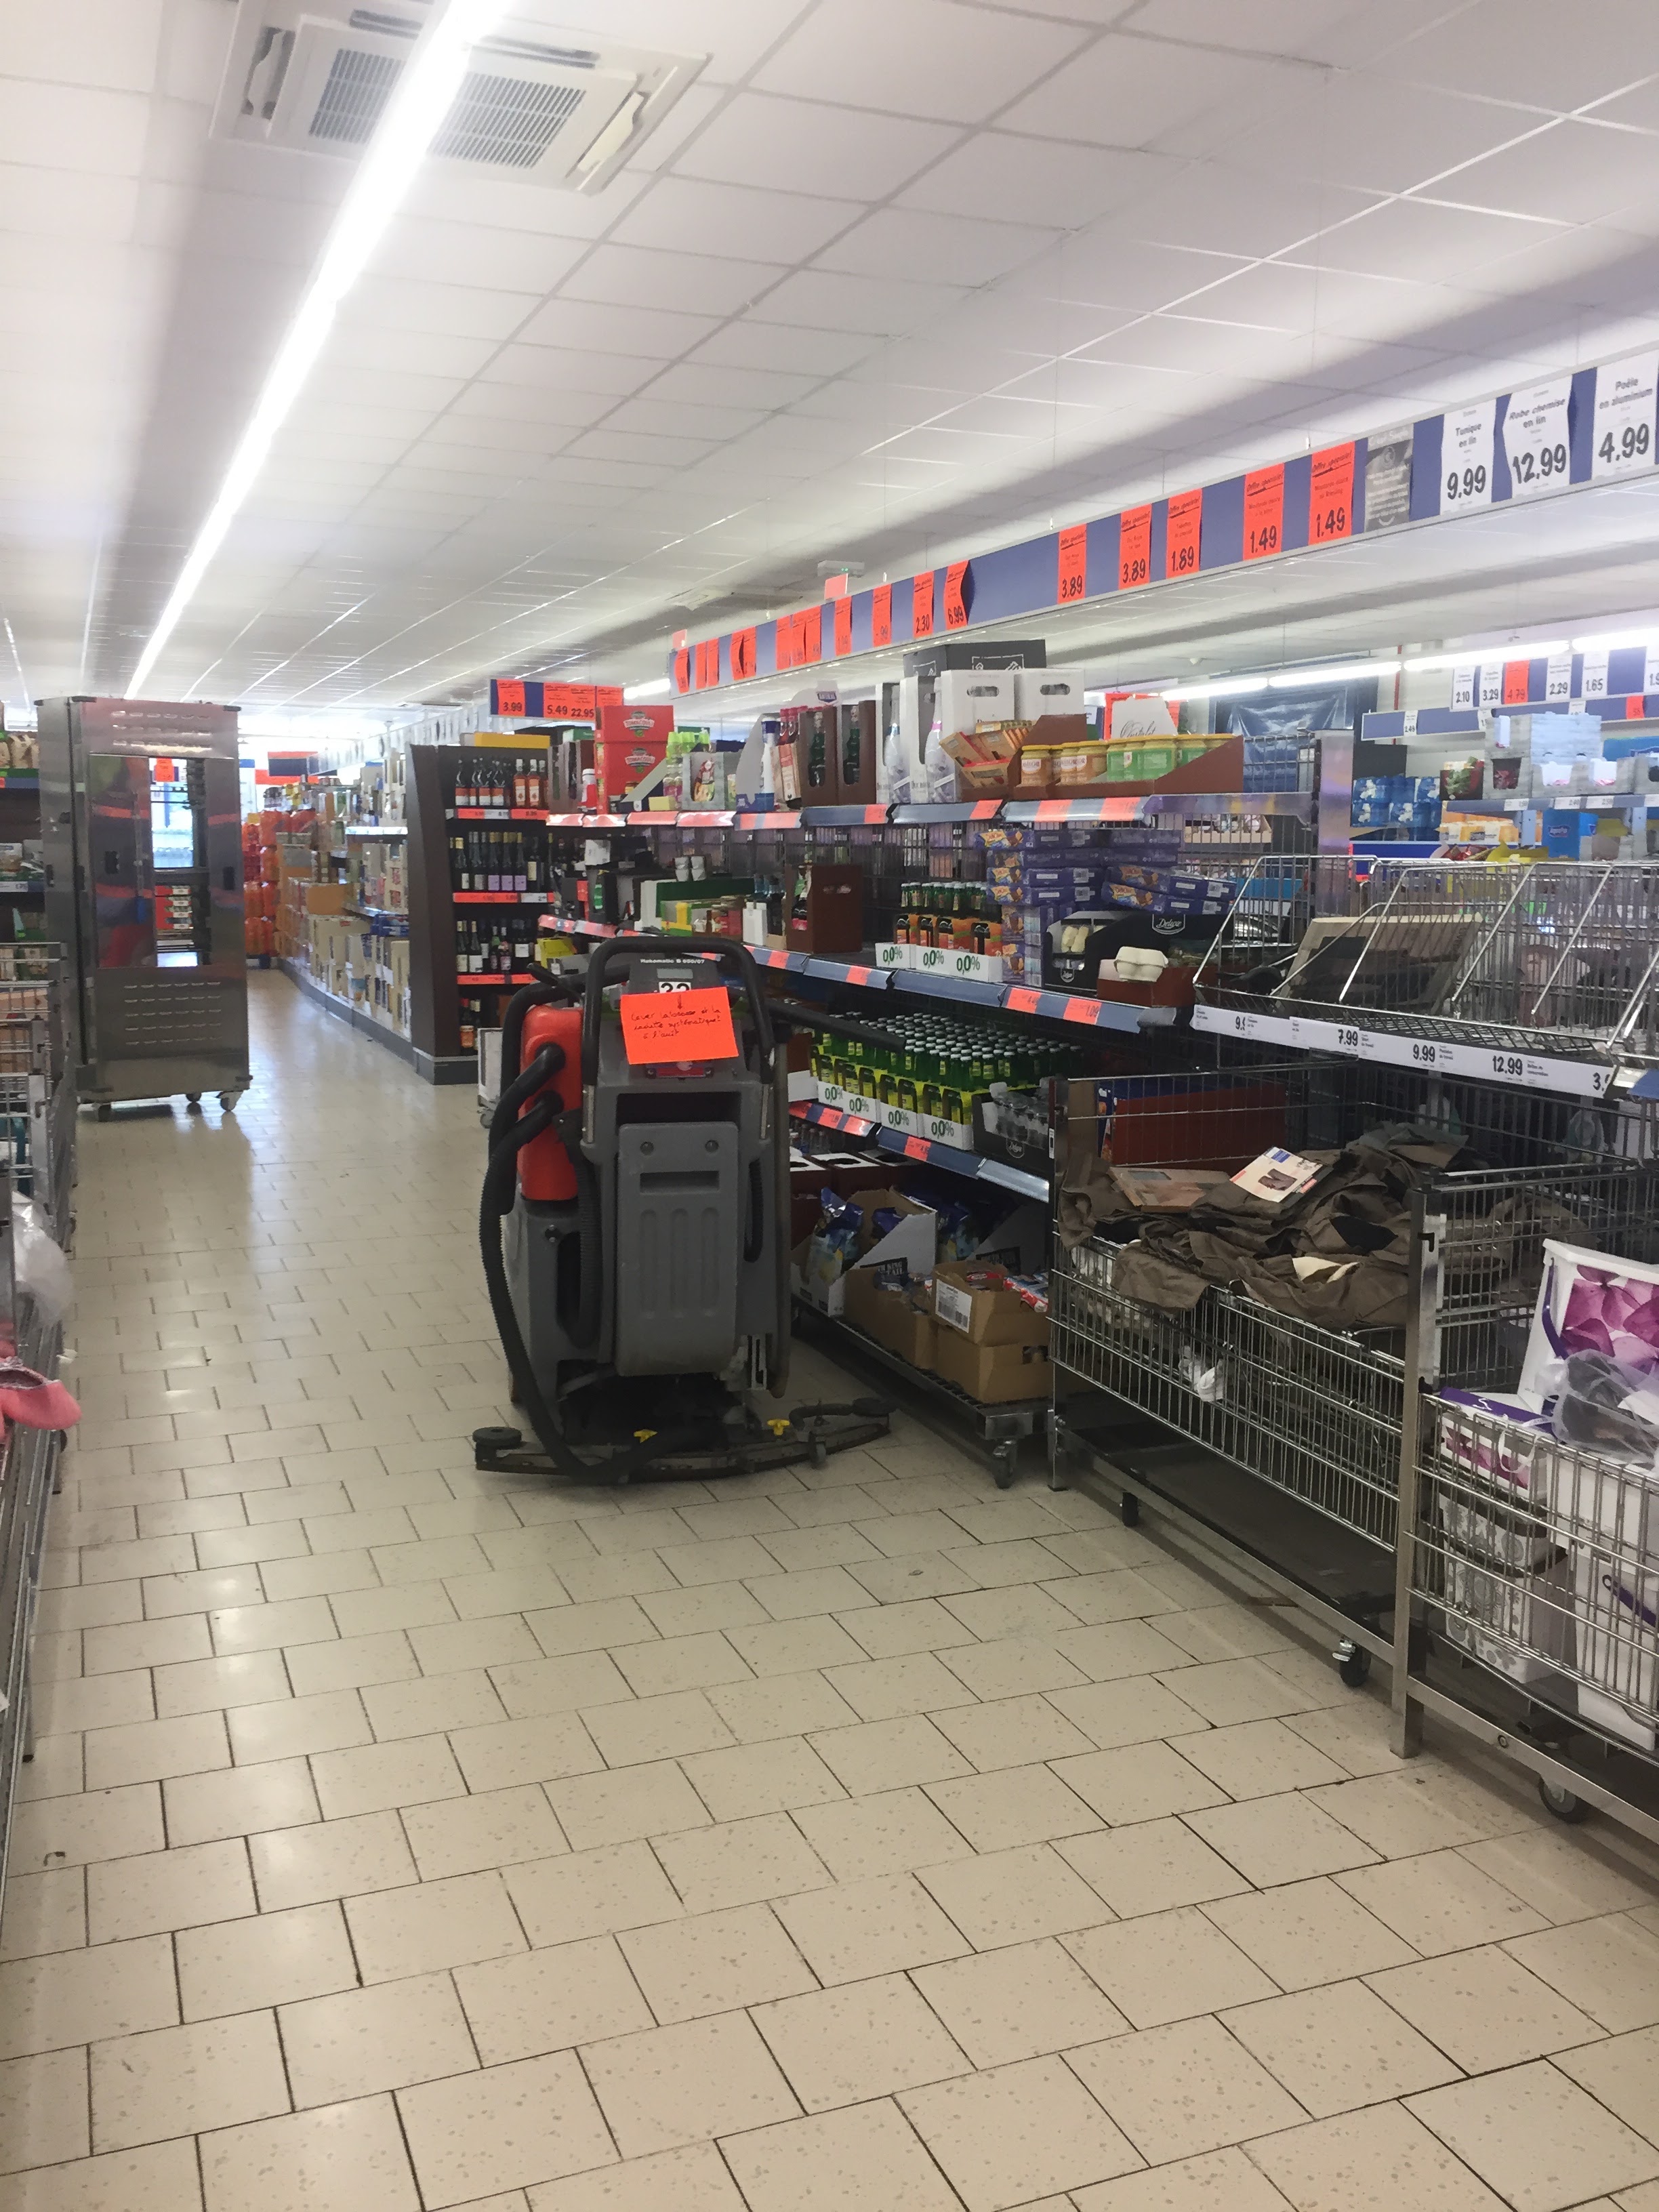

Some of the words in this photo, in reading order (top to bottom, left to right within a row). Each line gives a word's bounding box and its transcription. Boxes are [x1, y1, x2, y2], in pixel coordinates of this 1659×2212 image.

[1599, 423, 1650, 463] 4.99
[1513, 444, 1566, 484] 12.99
[1447, 465, 1486, 499] 9.99
[1316, 506, 1345, 537] 1.49
[1250, 525, 1277, 554] 1.49
[1171, 545, 1195, 572] 1.89
[1122, 558, 1146, 583] 3.89
[1061, 575, 1082, 598] 3.89
[947, 605, 964, 625] 6.99
[1483, 688, 1498, 701] 3.29
[1549, 682, 1568, 695] 2.29
[1586, 678, 1603, 692] 1.65
[503, 701, 523, 712] 3.99
[1456, 691, 1470, 703] 2.10
[547, 704, 568, 716] 5.49
[1156, 918, 1182, 929] Deluxe
[883, 946, 903, 965] 0,0%
[923, 949, 944, 968] 0,0%
[956, 955, 980, 975] 0,0%
[1338, 1029, 1358, 1046] 7.99
[1413, 1044, 1435, 1063] 9.99
[1492, 1055, 1523, 1076] 12.99
[849, 1097, 869, 1114] 0,0%
[888, 1109, 909, 1128] 0,0%
[931, 1120, 954, 1139] 0,0%
